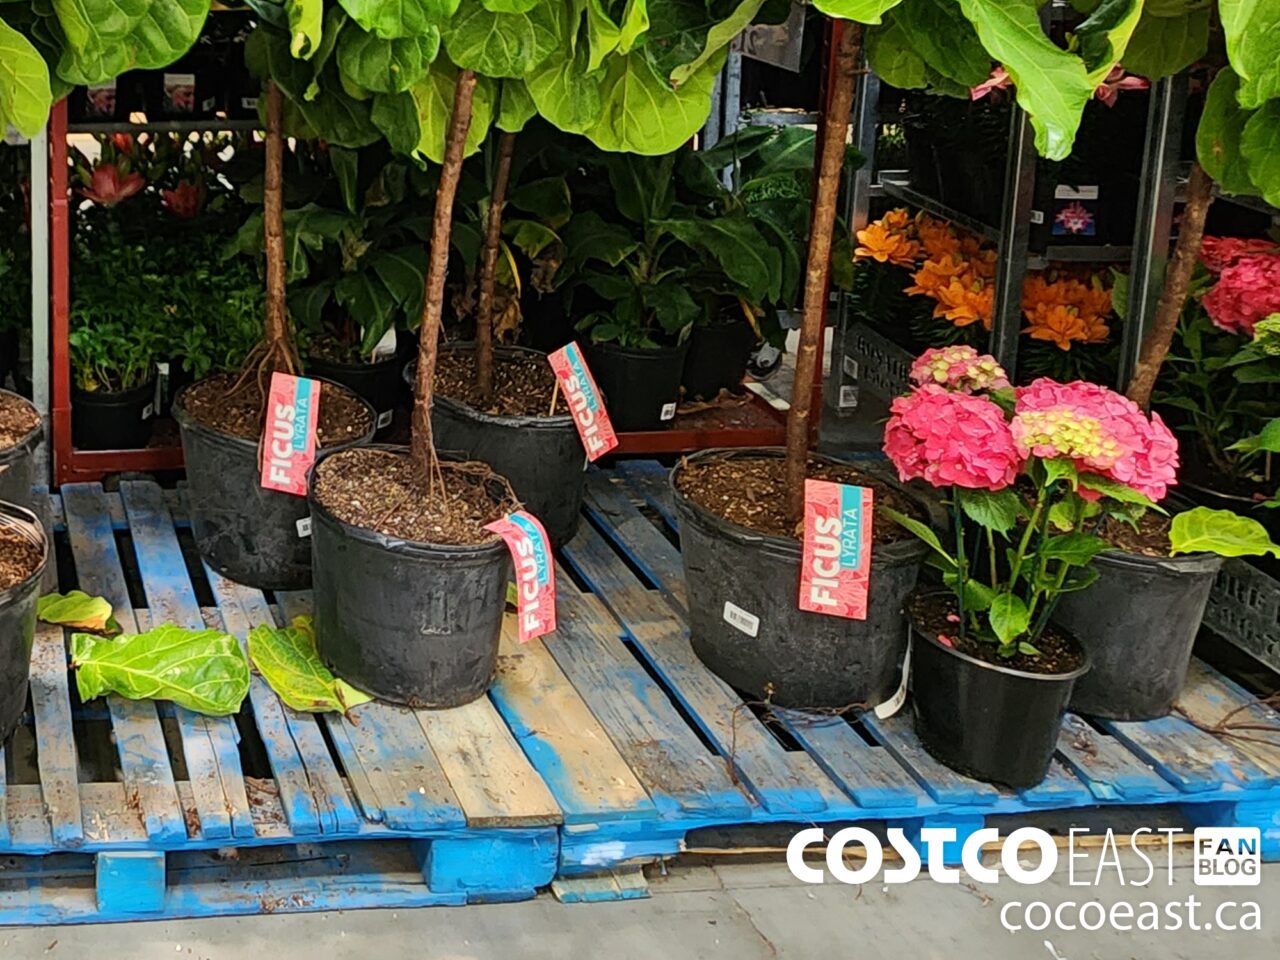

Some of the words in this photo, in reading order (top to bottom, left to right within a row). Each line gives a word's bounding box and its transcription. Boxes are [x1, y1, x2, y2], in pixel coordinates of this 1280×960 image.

[269, 403, 296, 486] FICUS
[293, 397, 308, 451] LYRATA
[565, 374, 604, 453] FICUS
[524, 524, 547, 582] LYRATA
[811, 514, 843, 607] FICUS
[841, 507, 859, 569] LYRATA
[515, 536, 540, 633] FICUS
